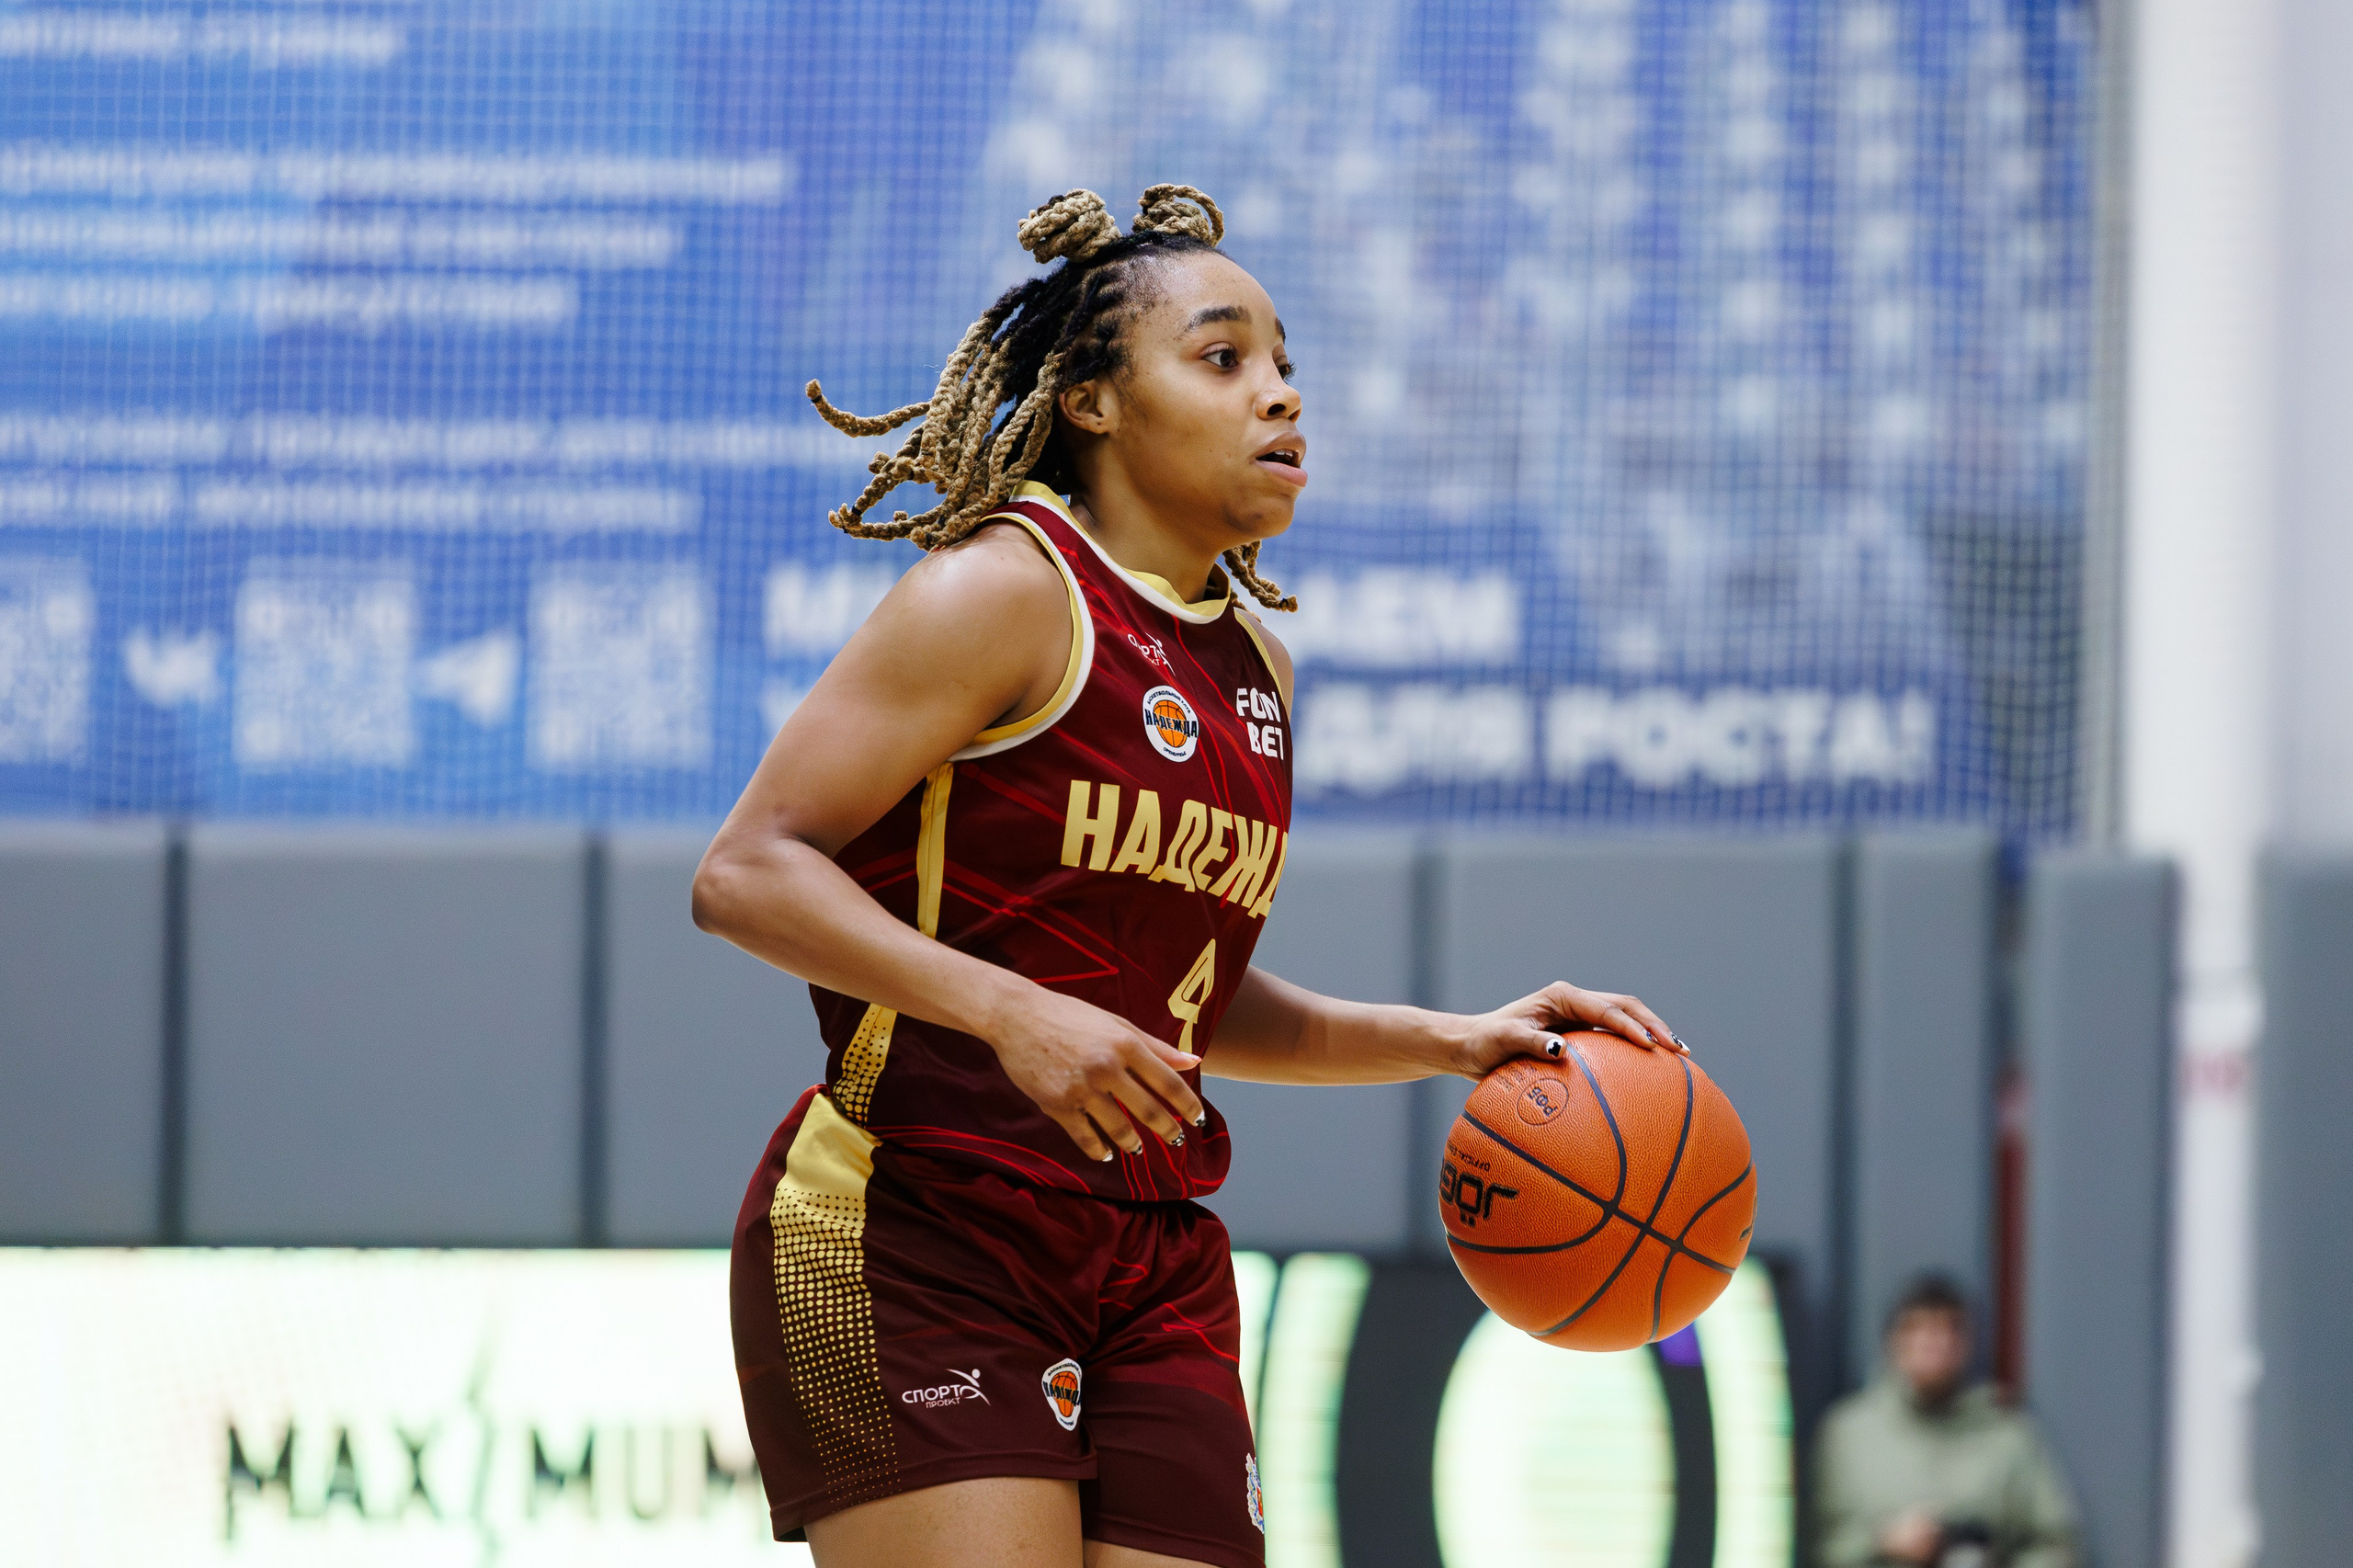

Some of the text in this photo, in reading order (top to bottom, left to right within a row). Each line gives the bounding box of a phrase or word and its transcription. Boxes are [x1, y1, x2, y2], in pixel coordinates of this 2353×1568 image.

[1236, 687, 1281, 722] FON
[1144, 708, 1198, 738] НАДЕЖДА
[1246, 722, 1284, 760] BET
[1167, 937, 1216, 1054] 4
[1438, 1160, 1519, 1227] JÖG
[902, 1383, 962, 1404] СПОРТ
[926, 1397, 961, 1409] ПРОЕКТ
